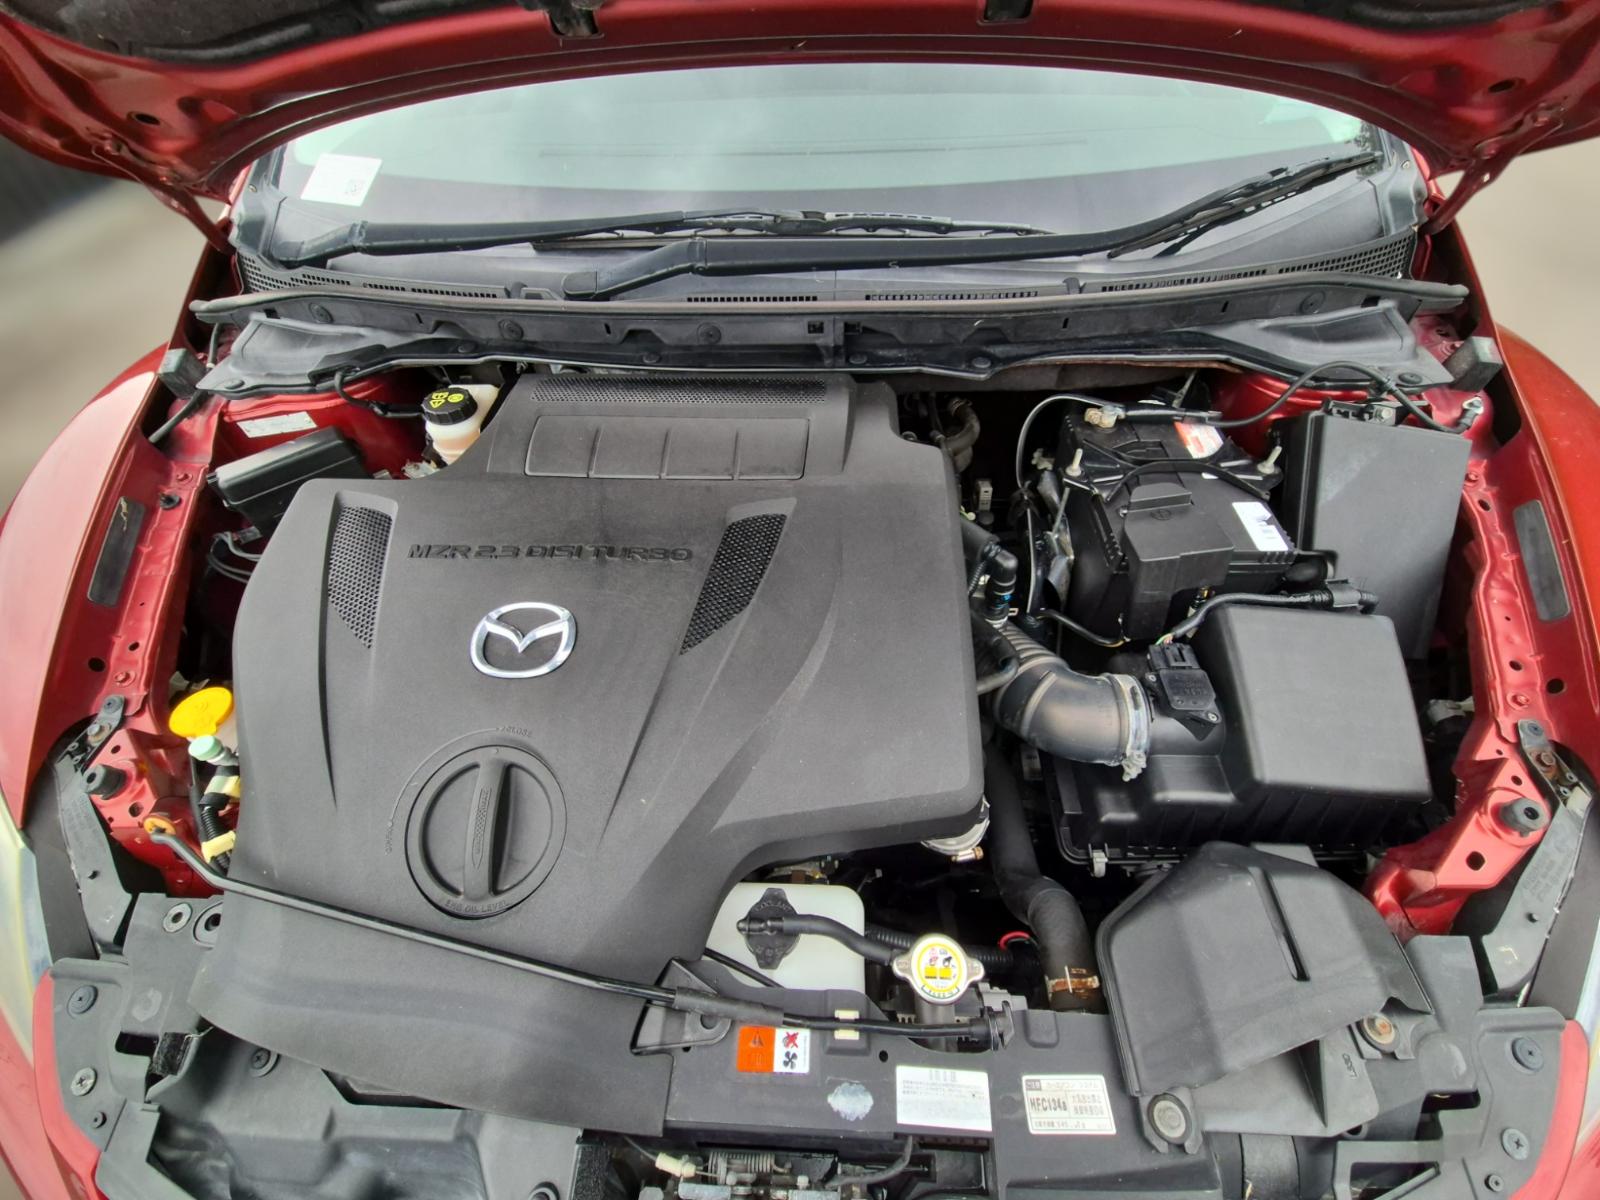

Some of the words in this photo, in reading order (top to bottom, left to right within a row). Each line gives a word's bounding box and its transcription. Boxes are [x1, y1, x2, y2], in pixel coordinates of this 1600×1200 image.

[407, 544, 472, 559] MZR
[474, 544, 520, 559] 2.3
[524, 544, 583, 560] DISI
[588, 544, 693, 563] TURBO
[1029, 1096, 1068, 1112] HFC134a
